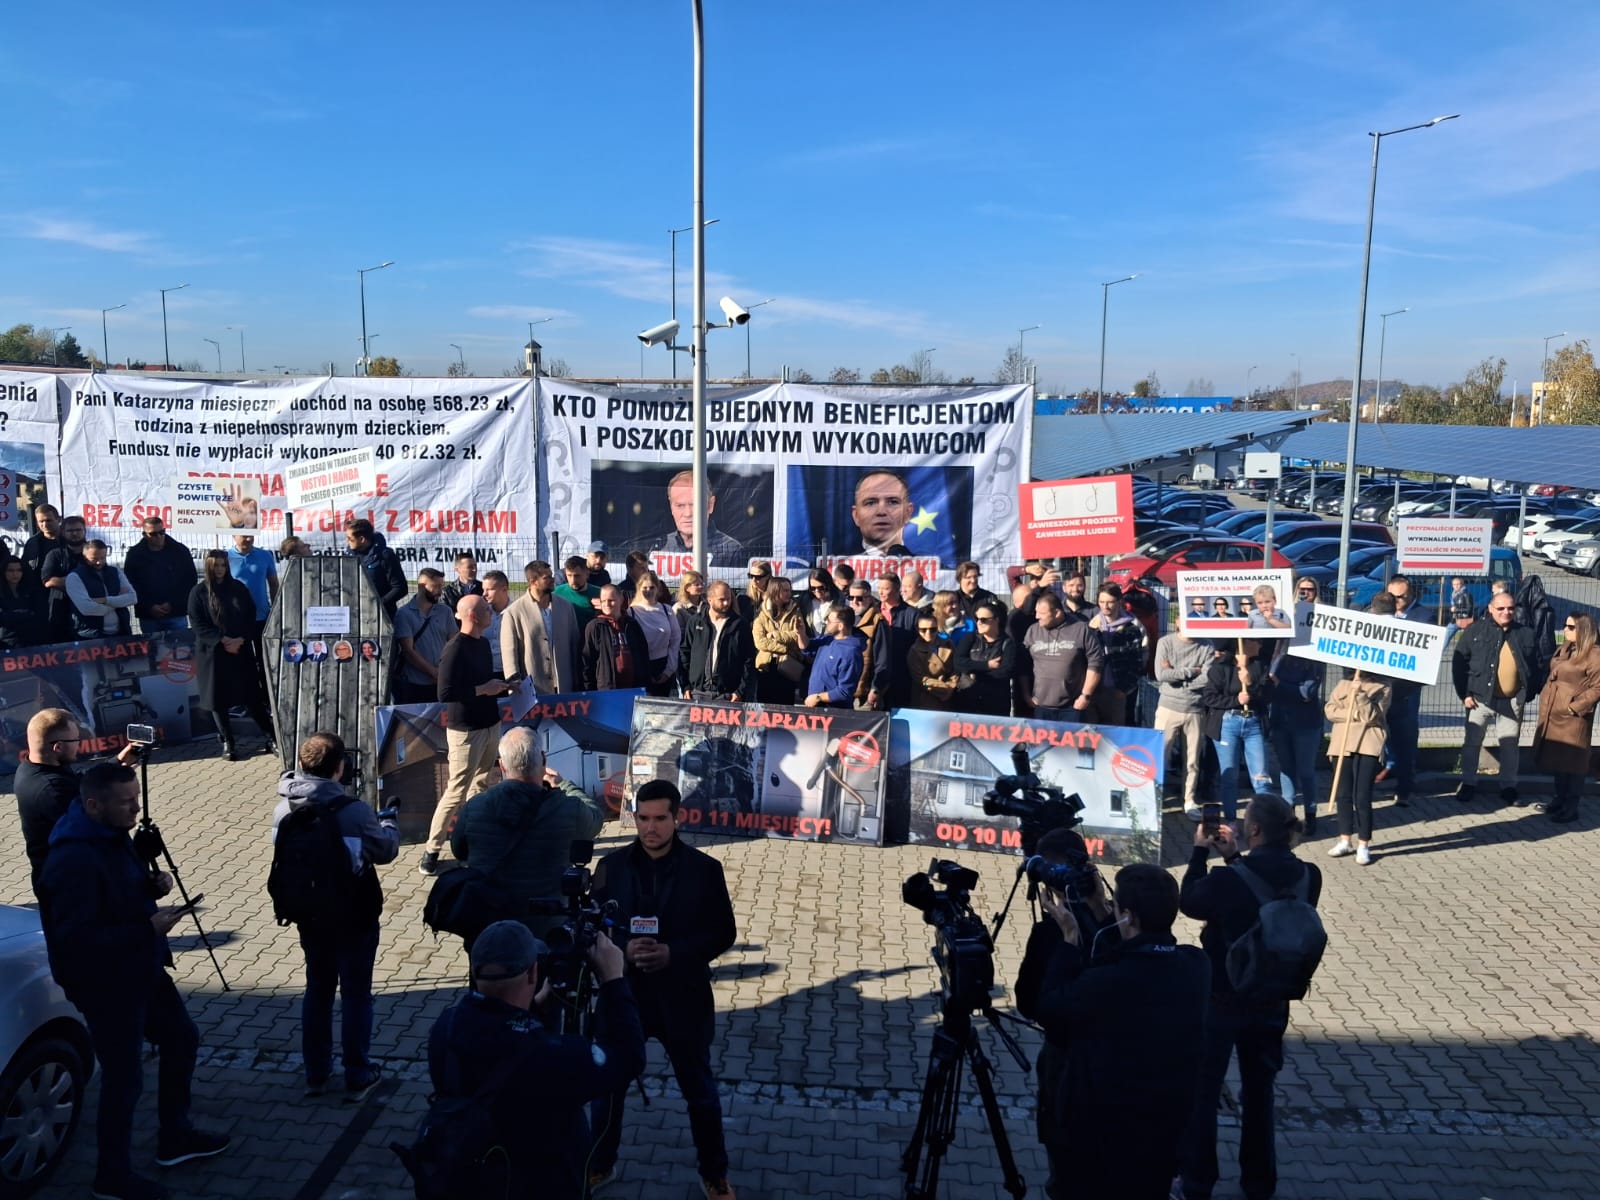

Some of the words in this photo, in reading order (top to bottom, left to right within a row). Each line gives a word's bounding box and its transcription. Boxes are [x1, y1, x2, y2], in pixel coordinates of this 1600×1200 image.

[76, 391, 107, 406] Pani
[113, 392, 194, 413] Katarzyna
[201, 395, 281, 415] miesięczn
[290, 394, 347, 411] dochód
[354, 398, 372, 411] na
[379, 395, 426, 415] osobę
[433, 395, 489, 411] 568.23
[495, 394, 515, 414] zł,
[552, 394, 596, 419] KTO
[711, 400, 813, 423] BIEDNYM
[824, 401, 1015, 425] BENEFICJENTOM
[135, 418, 193, 434] rodzina
[200, 421, 207, 434] z
[213, 418, 358, 438] niepełnosprawnym
[365, 419, 450, 436] dzieckiem.
[580, 425, 587, 447] I
[597, 427, 802, 453] POSZKODOWANYM
[812, 431, 986, 454] WYKONAWCOM
[109, 440, 170, 457] Fundusz
[176, 442, 201, 458] nie
[208, 443, 273, 462] wypłacił
[280, 444, 359, 463] wykona
[376, 444, 395, 460] 40
[401, 444, 456, 460] 812.32
[462, 444, 482, 460] zł.
[177, 483, 213, 491] CZYSTE
[177, 493, 234, 502] POWIETRZE
[82, 503, 123, 527] BEZ
[385, 509, 400, 532] Z
[409, 508, 517, 534] DŁUGAMI
[177, 508, 221, 517] NIECZYSTA
[1027, 519, 1081, 529] ZAWIESZONE
[1082, 515, 1124, 525] PROJEKTY
[1035, 529, 1086, 539] ZAWIESZENI
[1087, 526, 1117, 535] LUDZIE
[1407, 535, 1458, 543] WYKONALIŚMY
[653, 554, 694, 577] TUS
[819, 558, 938, 581] WROCKI
[1231, 574, 1282, 582] HAMAKACH
[3, 651, 59, 672] BRAK
[63, 641, 150, 664] ZAPŁATY
[1317, 636, 1385, 665] NIECZYSTA
[1388, 651, 1416, 671] GRA
[501, 700, 593, 724] ZPŁATY
[689, 706, 743, 727] BRAK
[745, 710, 834, 732] ZAPŁATY
[948, 721, 1004, 742] BRAK
[1008, 726, 1103, 751] ZAPŁATY
[677, 807, 703, 825] OD
[709, 810, 728, 827] 11
[735, 811, 832, 838] MIESIĘCY!
[936, 822, 968, 841] OD
[972, 826, 996, 842] 10
